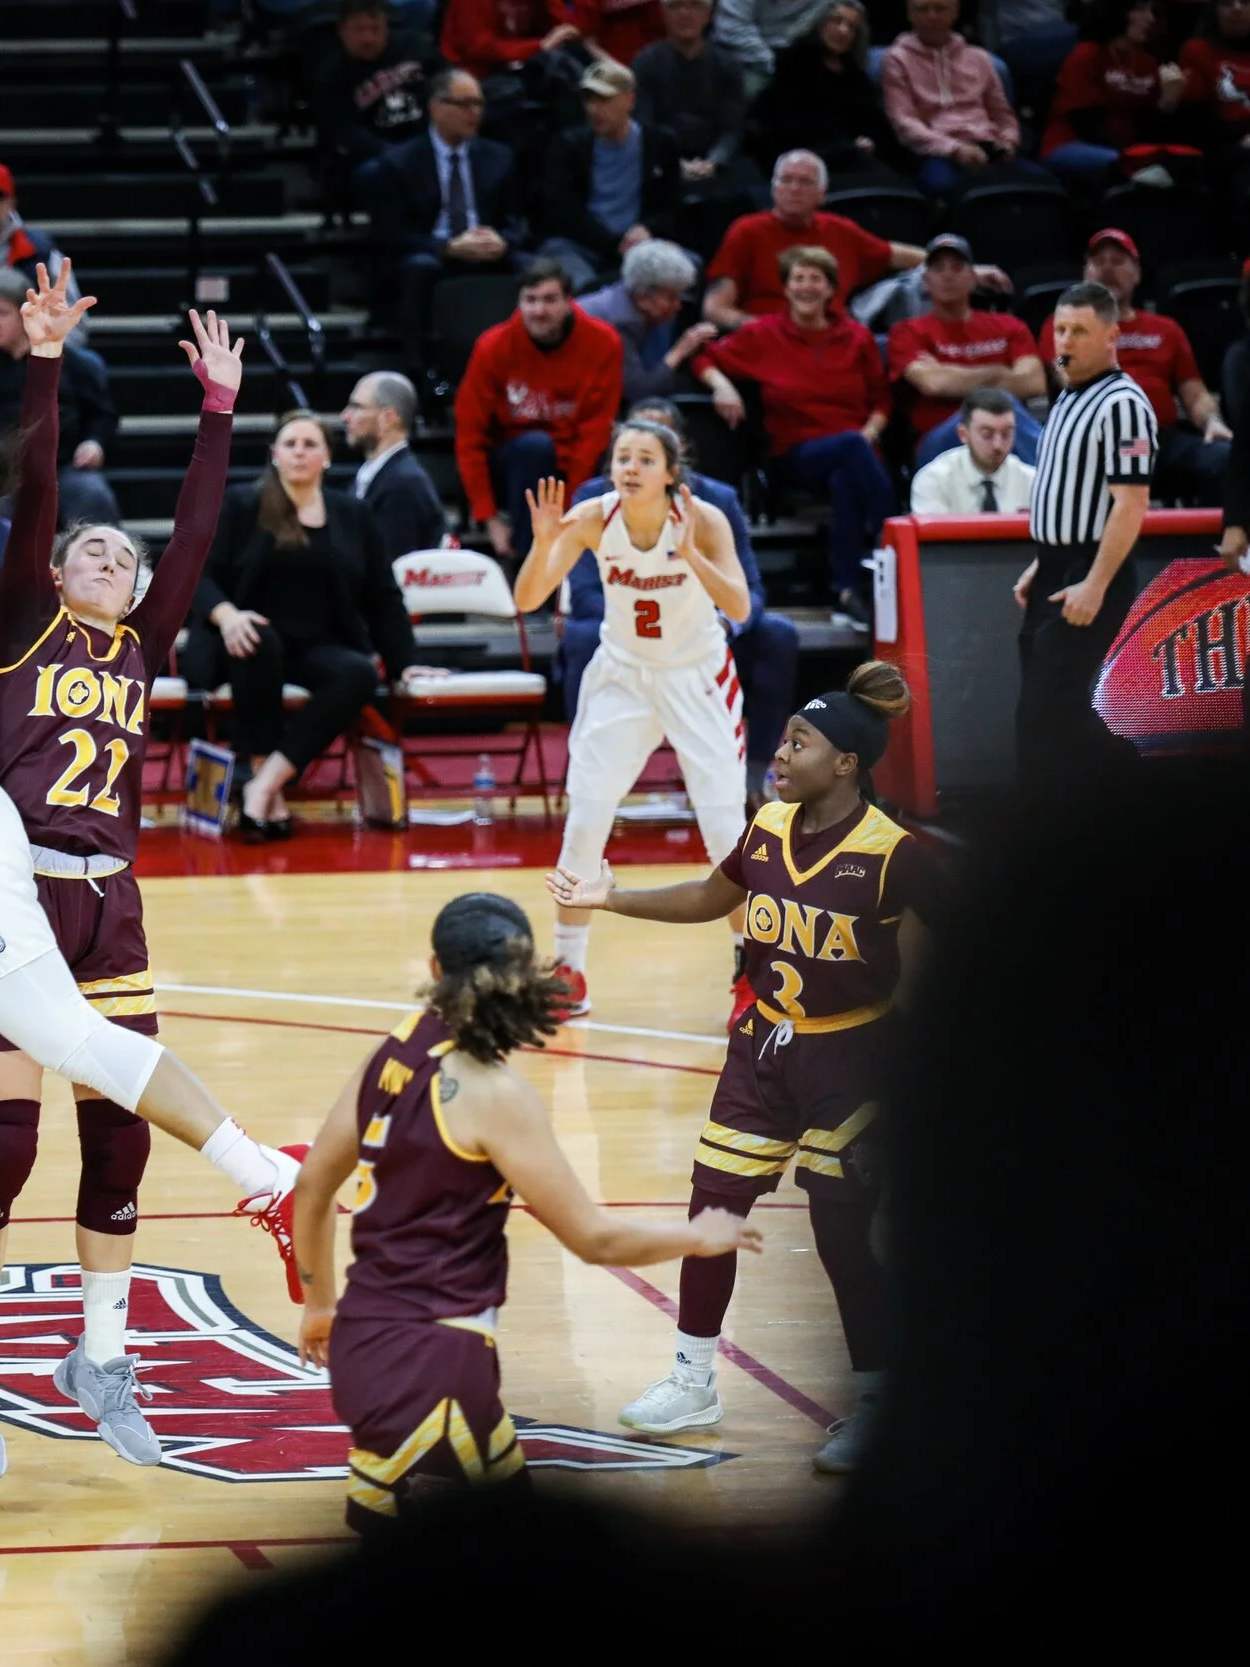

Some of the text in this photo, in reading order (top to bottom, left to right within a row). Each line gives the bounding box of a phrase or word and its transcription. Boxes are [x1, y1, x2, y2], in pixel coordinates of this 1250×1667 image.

[634, 599, 661, 639] 2
[1151, 593, 1250, 698] TH
[46, 728, 130, 817] 22
[770, 960, 807, 1018] 3
